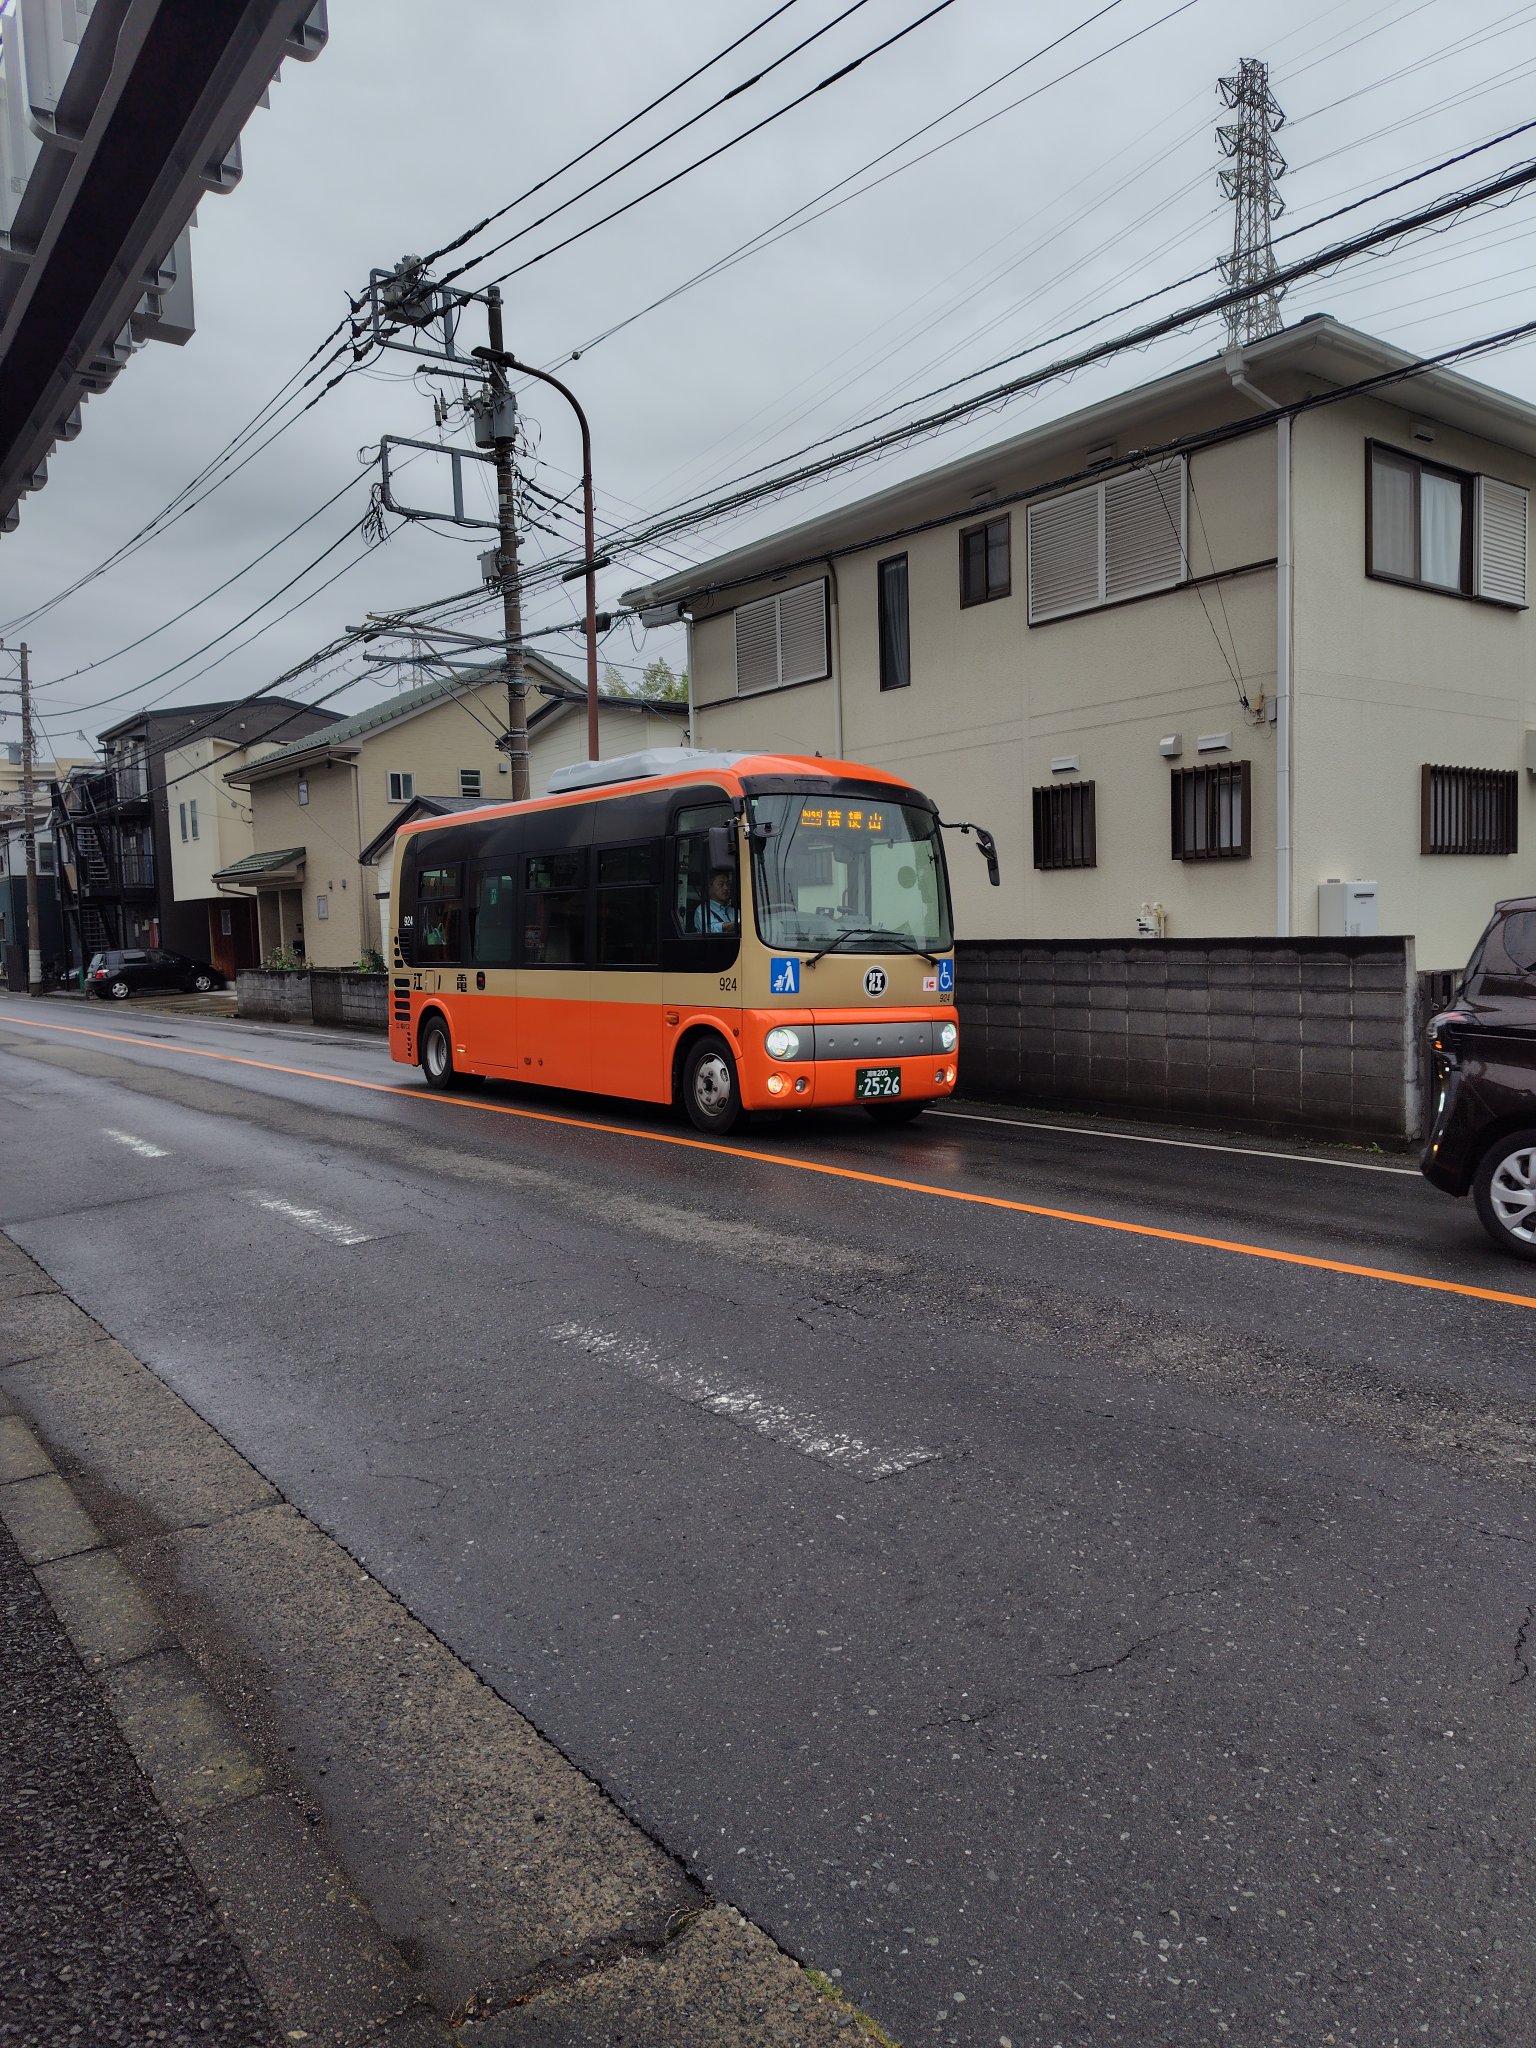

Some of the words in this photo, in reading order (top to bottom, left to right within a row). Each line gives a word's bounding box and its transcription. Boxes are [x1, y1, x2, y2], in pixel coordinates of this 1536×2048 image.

[413, 973, 467, 993] 江ノ電
[719, 977, 737, 991] 924
[940, 993, 950, 1003] 924
[864, 1076, 899, 1096] 25-26
